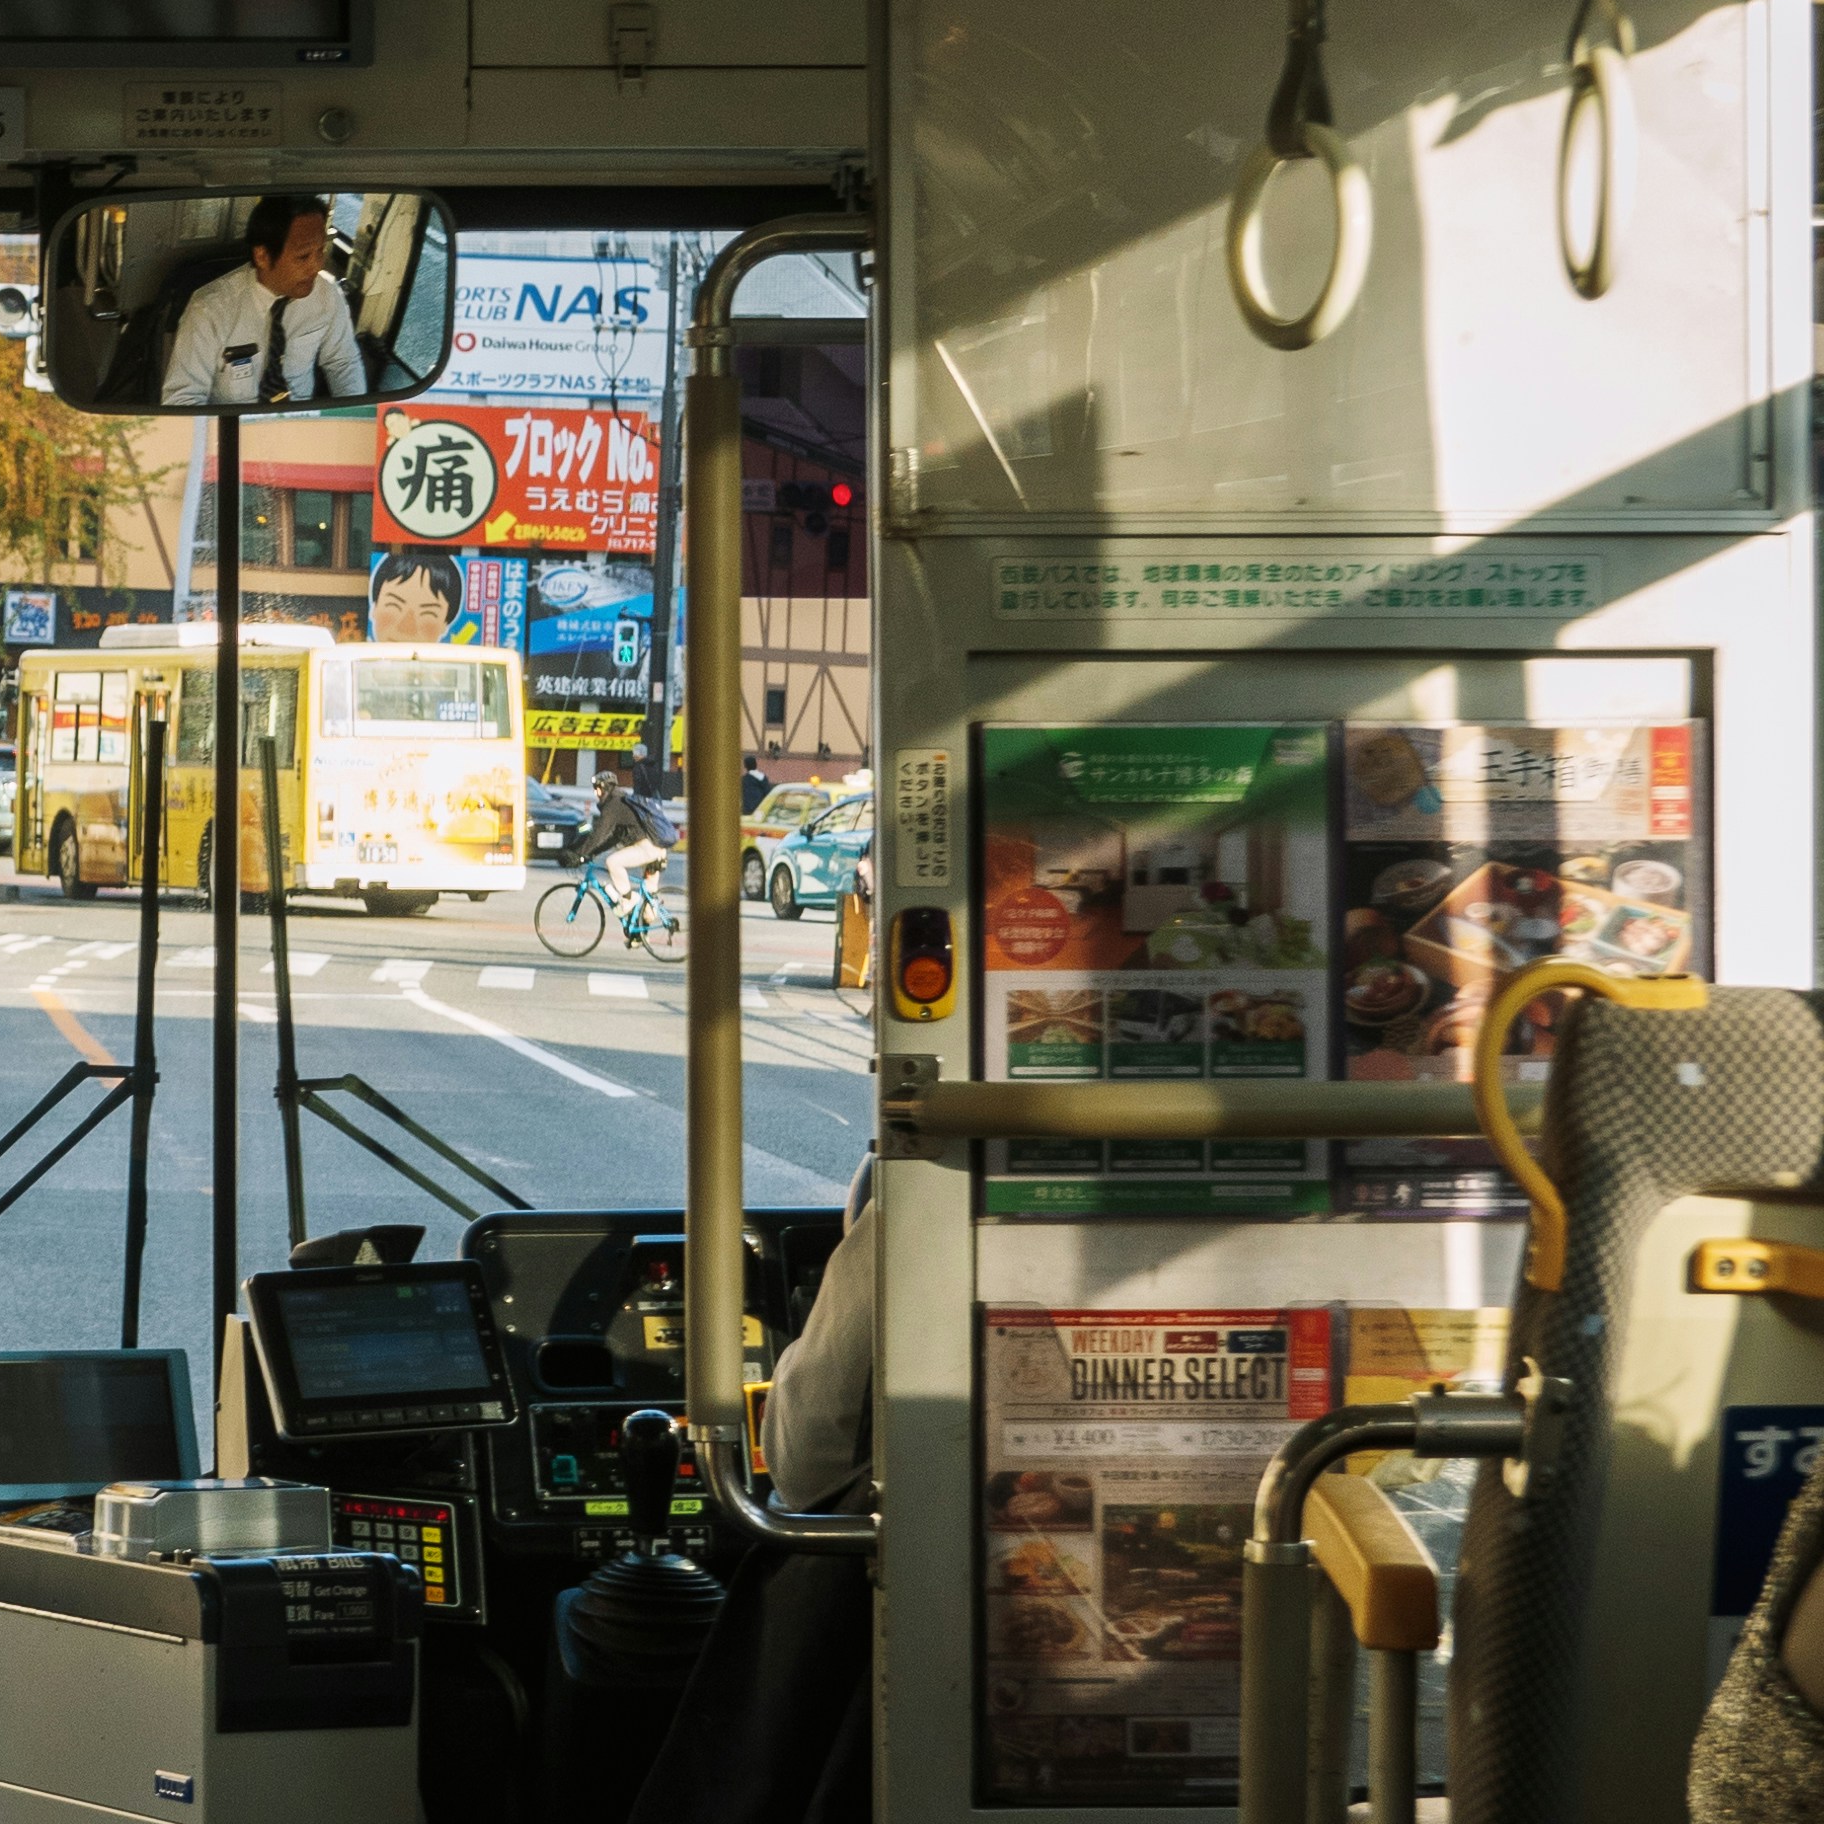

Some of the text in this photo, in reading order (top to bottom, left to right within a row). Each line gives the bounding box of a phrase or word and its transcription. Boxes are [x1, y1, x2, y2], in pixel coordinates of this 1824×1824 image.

[455, 286, 512, 303] ORTS
[513, 282, 651, 326] NAS
[481, 336, 528, 351] Daiwa
[528, 337, 573, 352] House
[450, 371, 596, 391] スポーツクラブNAS
[504, 411, 603, 484] ブロック
[397, 433, 474, 519] 痛
[525, 486, 625, 514] うえむら
[1071, 1330, 1157, 1354] WEEKDAY
[1071, 1357, 1175, 1401] DINNER
[1184, 1357, 1288, 1401] SELECT
